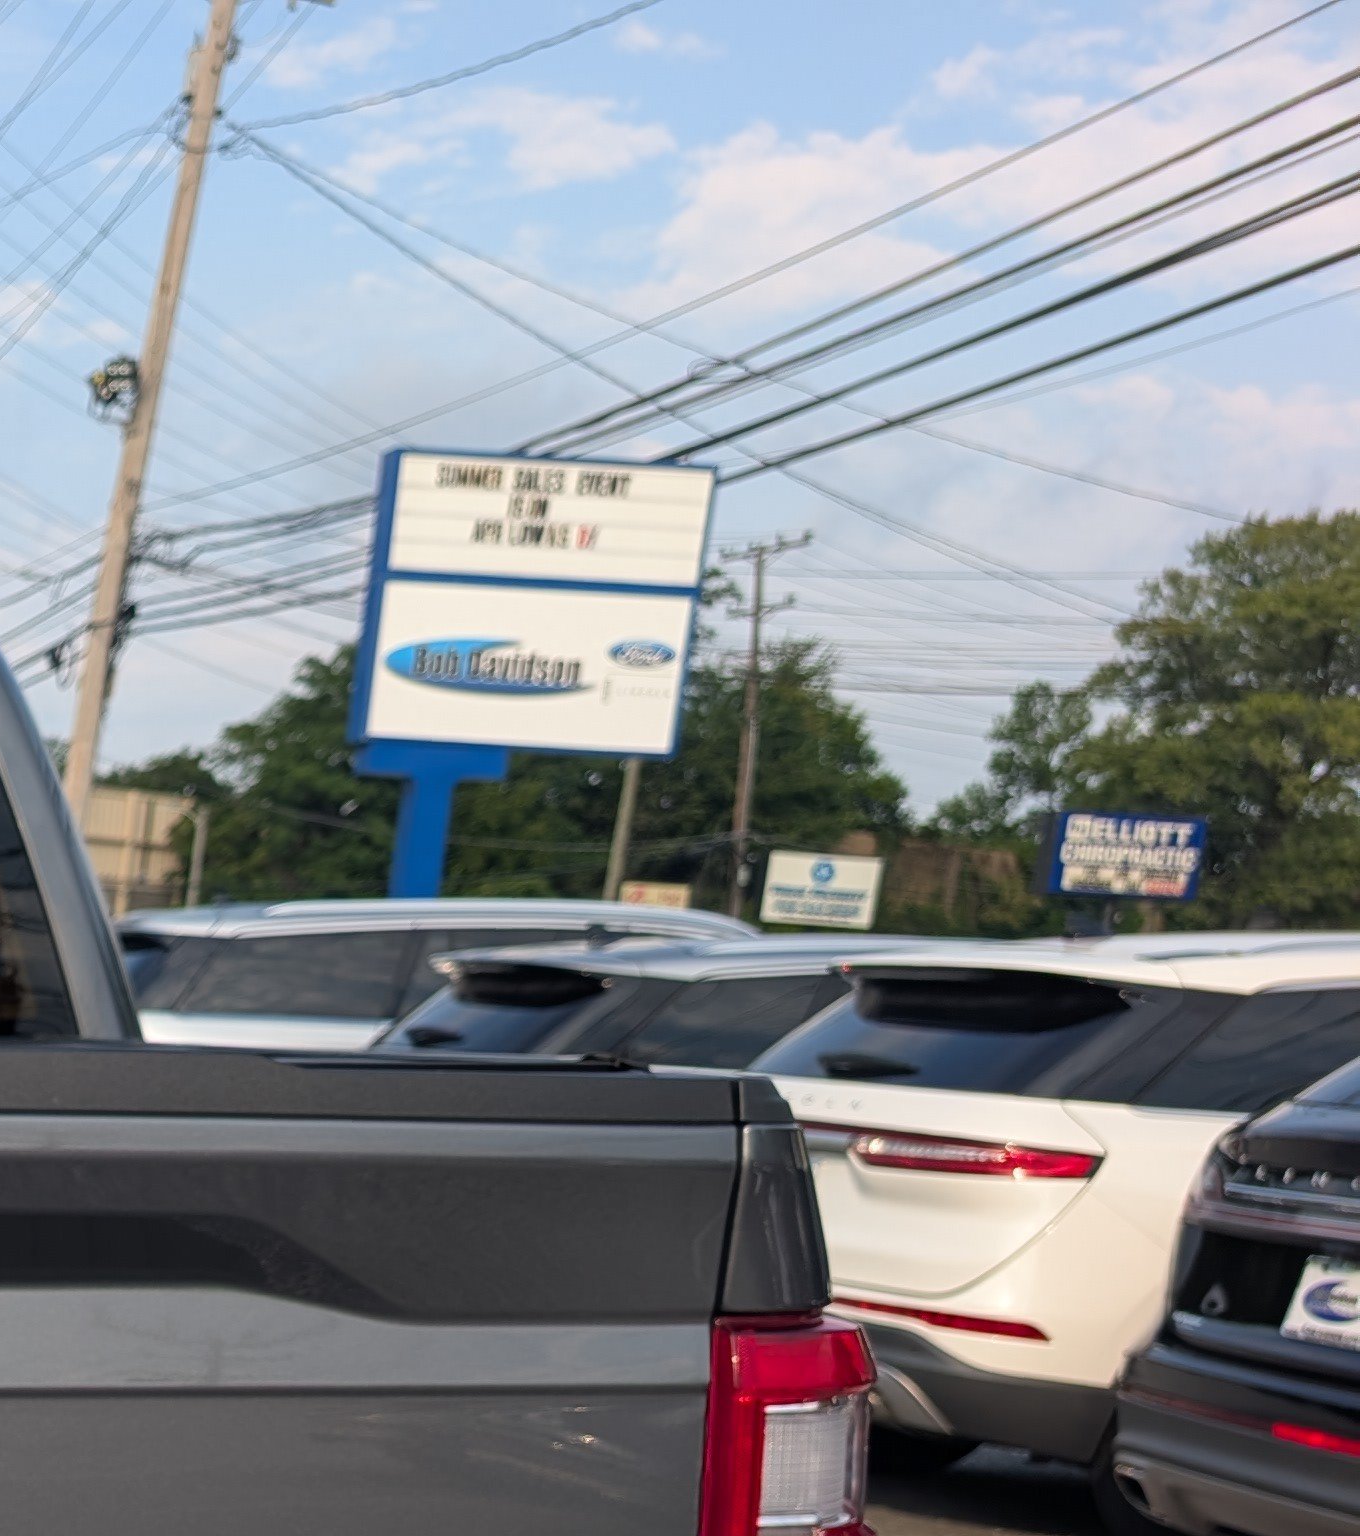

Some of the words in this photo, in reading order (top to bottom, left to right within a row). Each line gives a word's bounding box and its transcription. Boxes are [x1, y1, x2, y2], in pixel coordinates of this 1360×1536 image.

[437, 464, 503, 489] SUMMER
[511, 467, 566, 494] SALES
[578, 471, 631, 498] EVENT
[412, 645, 461, 681] Bob
[467, 648, 583, 688] Davidson
